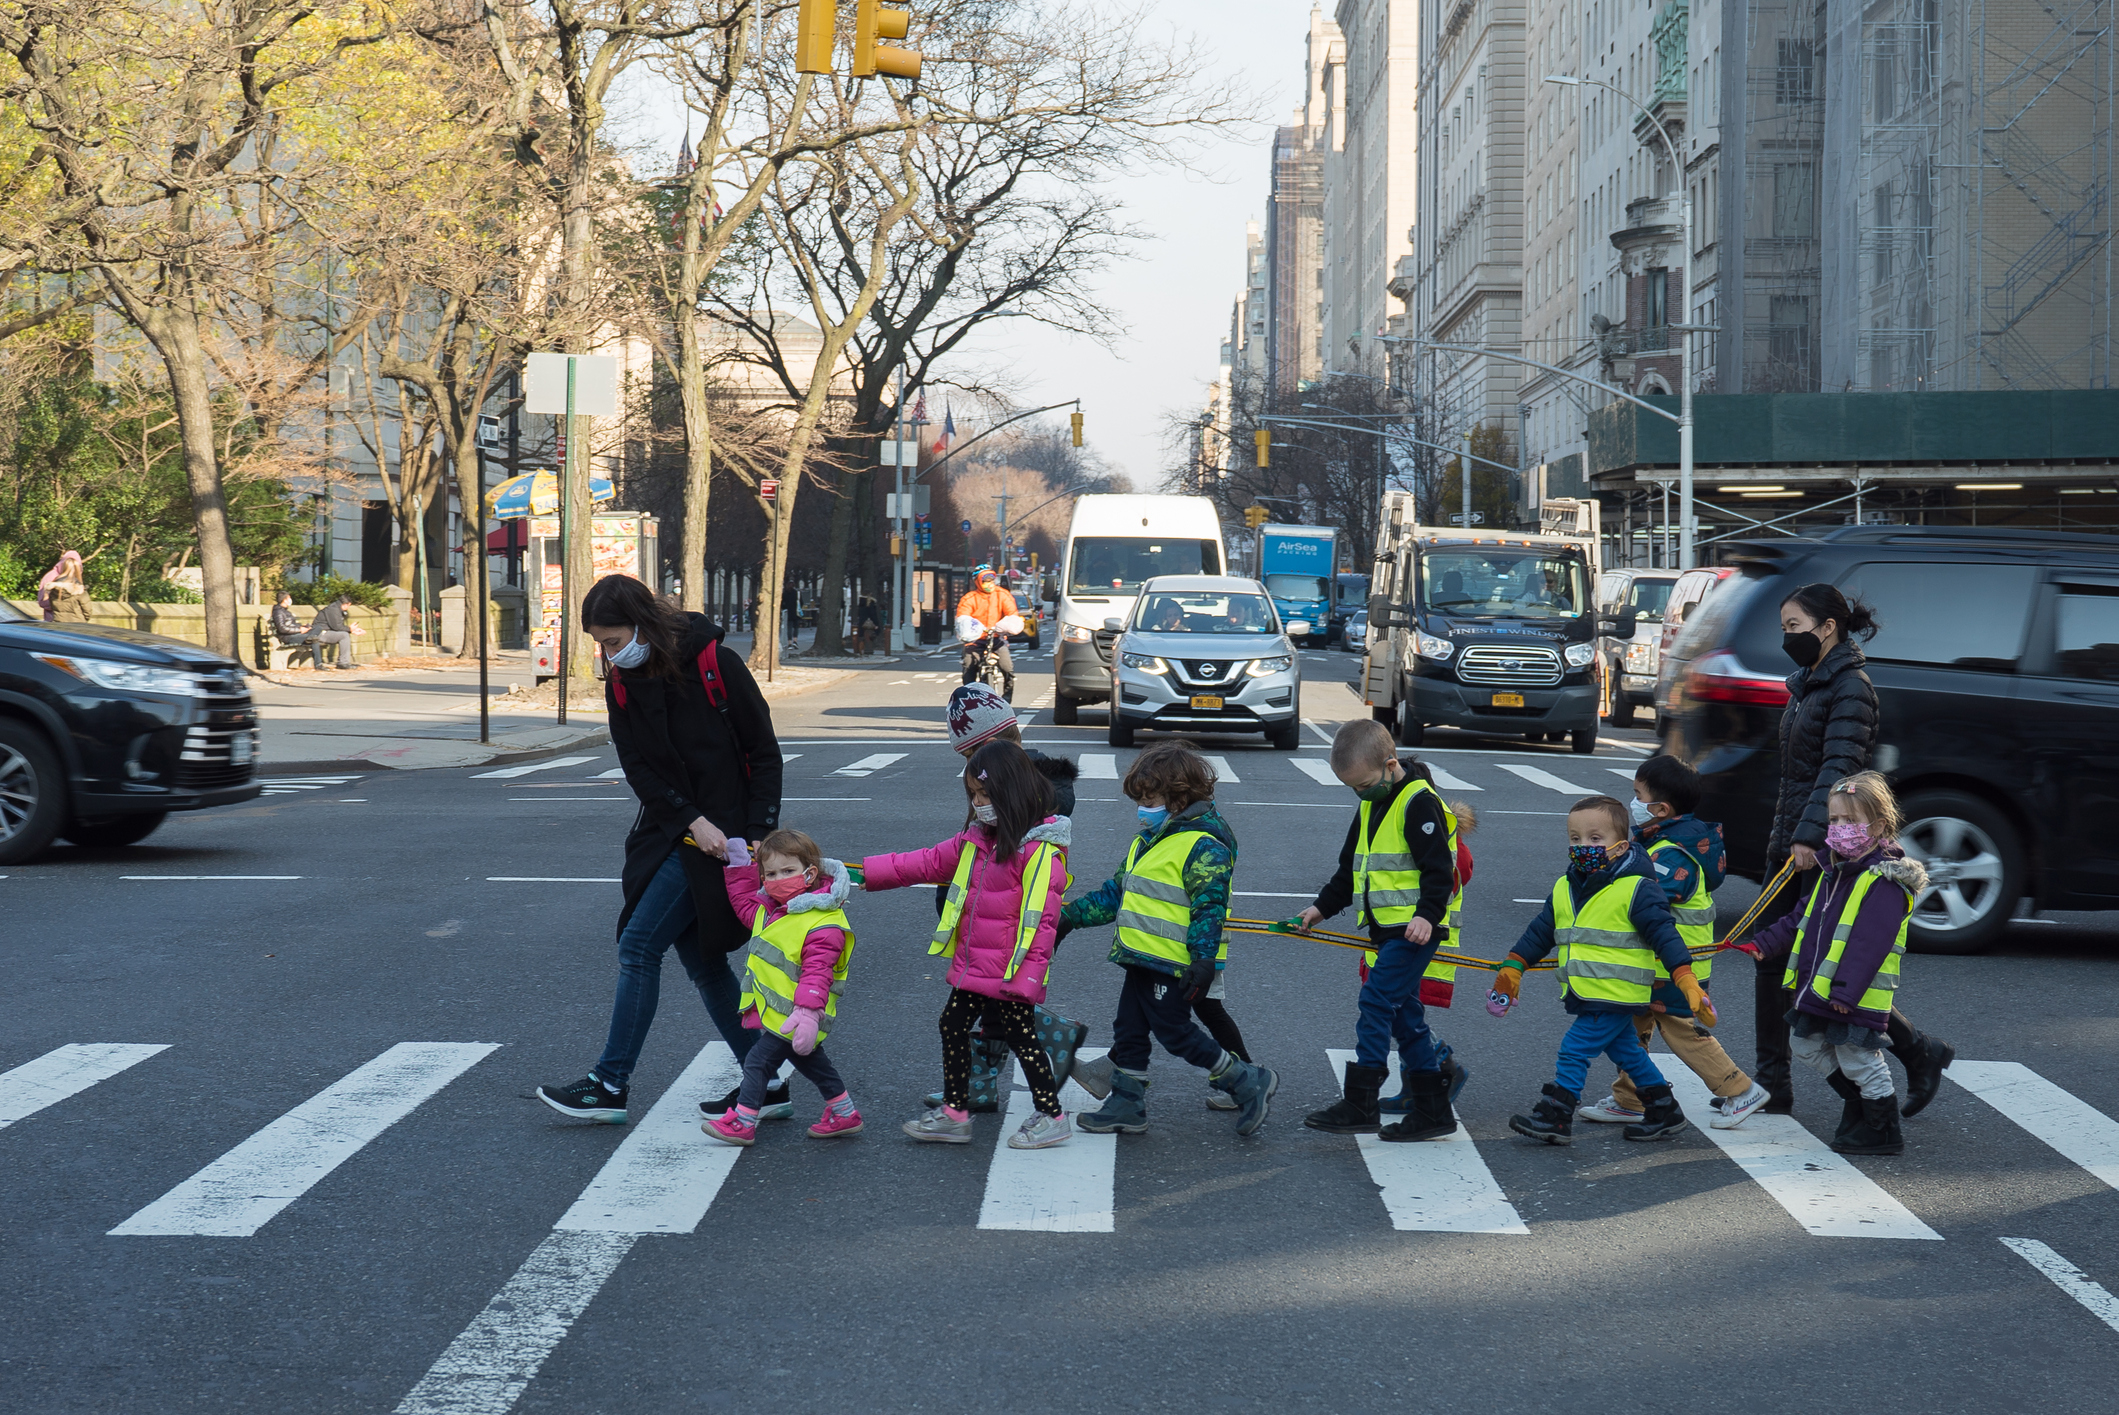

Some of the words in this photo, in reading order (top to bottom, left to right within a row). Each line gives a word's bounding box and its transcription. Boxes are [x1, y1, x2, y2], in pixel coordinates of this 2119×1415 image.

[1278, 541, 1318, 552] AirSea
[1448, 628, 1496, 637] FINEST
[1508, 628, 1570, 641] WINDOW
